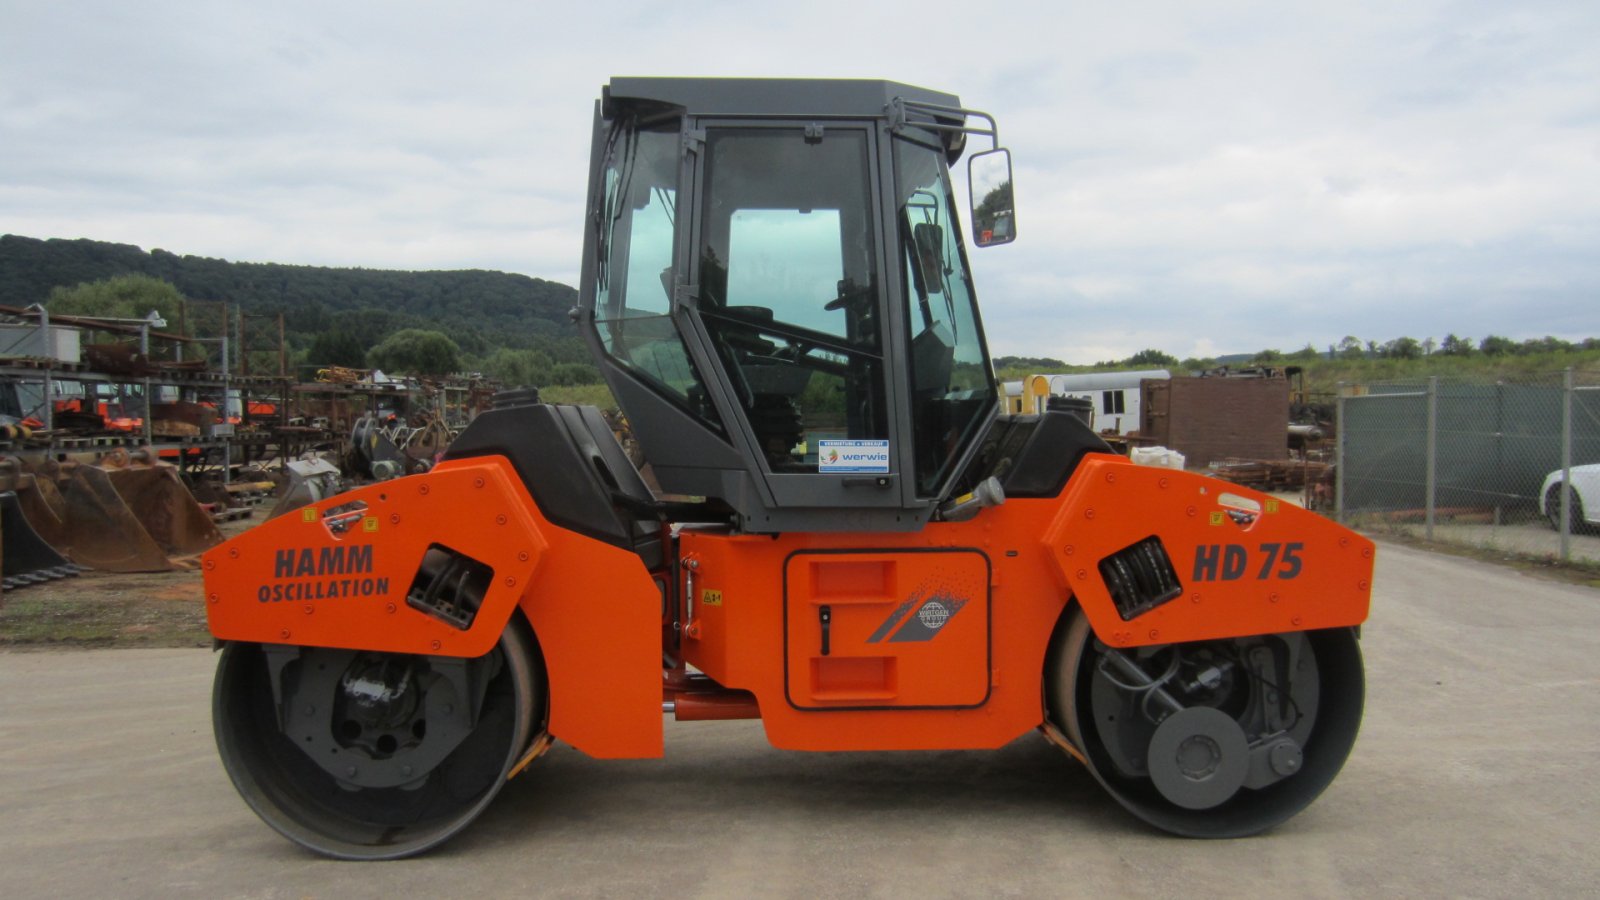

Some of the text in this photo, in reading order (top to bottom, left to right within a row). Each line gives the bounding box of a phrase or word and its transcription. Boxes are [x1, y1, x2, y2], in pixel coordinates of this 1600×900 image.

[275, 544, 373, 578] HAMM
[1192, 542, 1304, 581] HD 75
[258, 577, 389, 603] OSCILLATION
